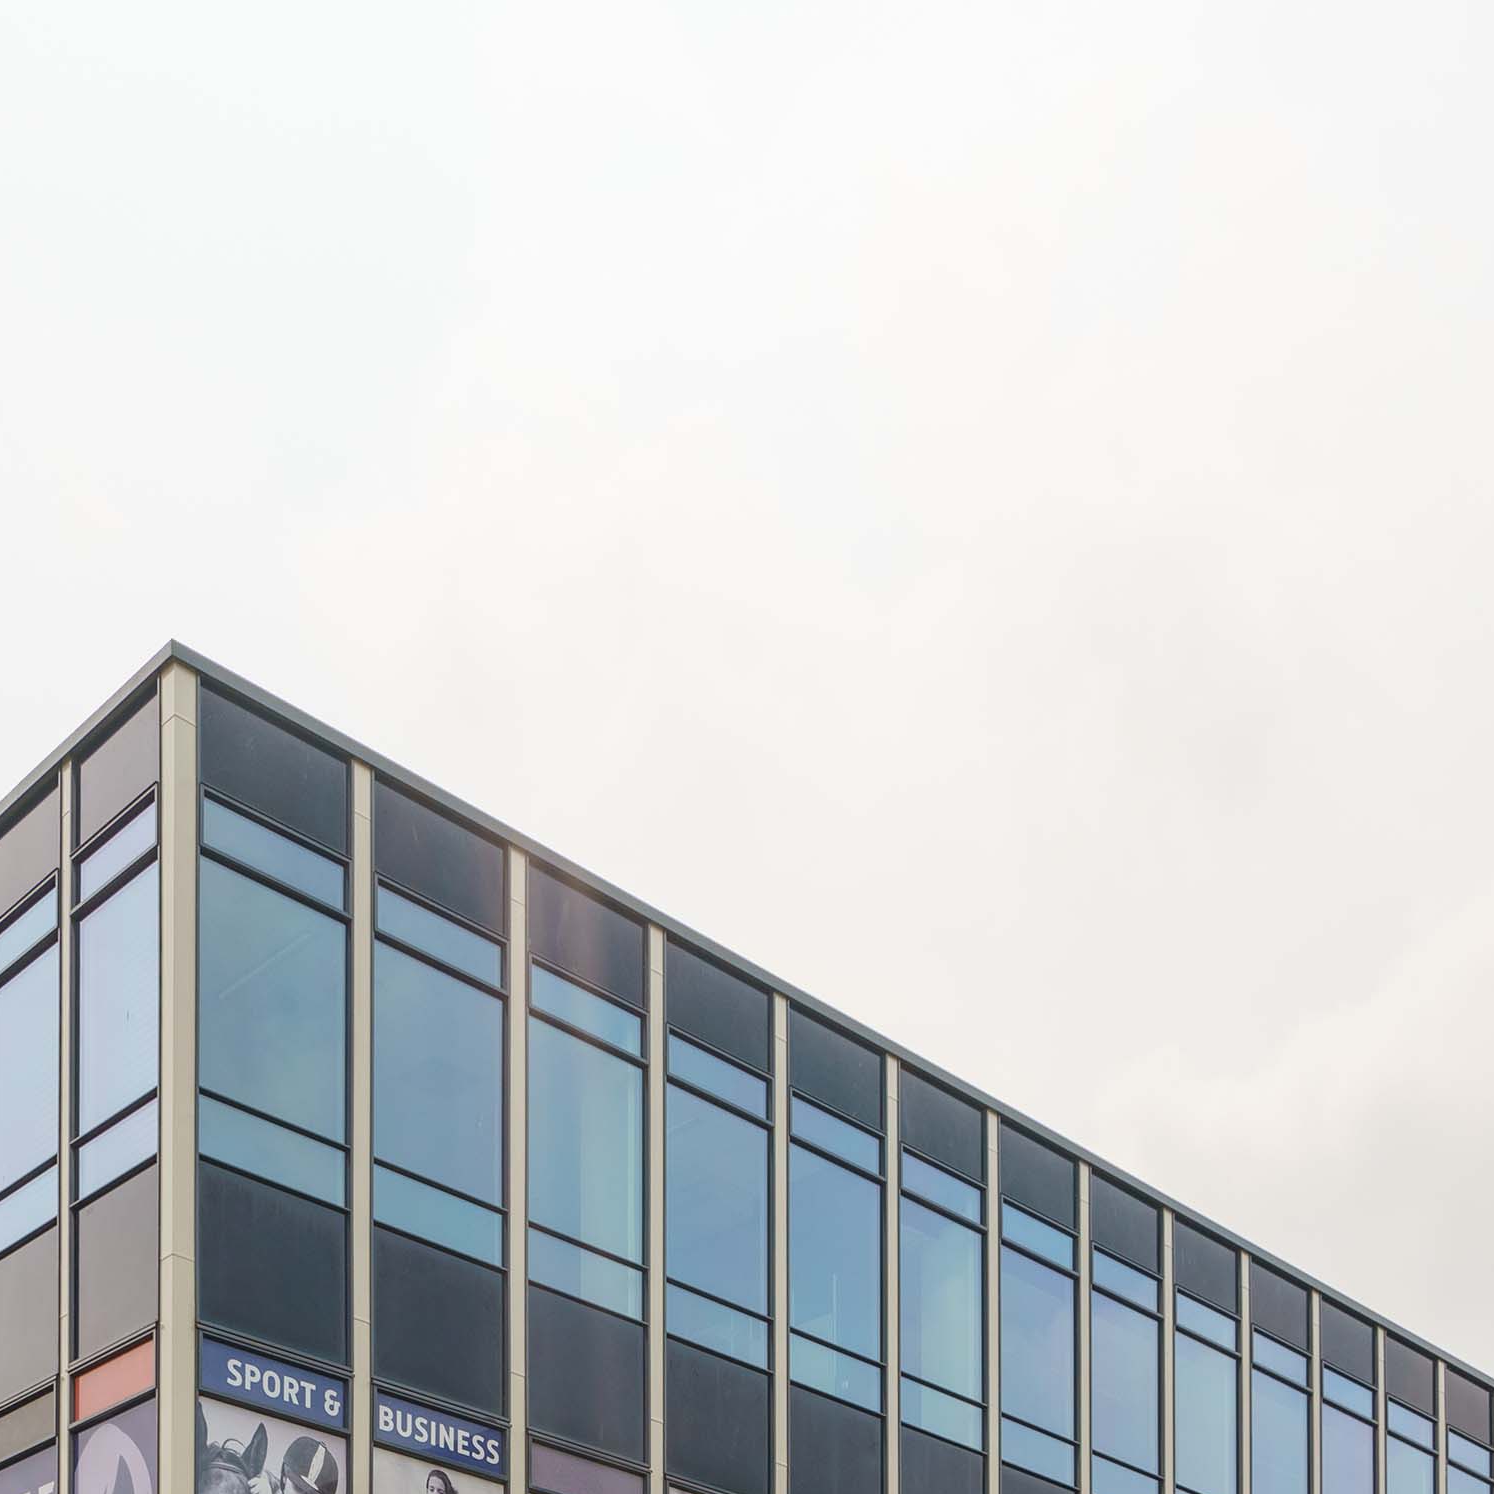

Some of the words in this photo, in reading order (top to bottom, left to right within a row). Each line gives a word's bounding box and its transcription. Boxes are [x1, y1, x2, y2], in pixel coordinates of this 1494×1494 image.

[225, 1357, 318, 1412] SPORT
[323, 1386, 341, 1418] &
[378, 1403, 500, 1465] BUSINESS
